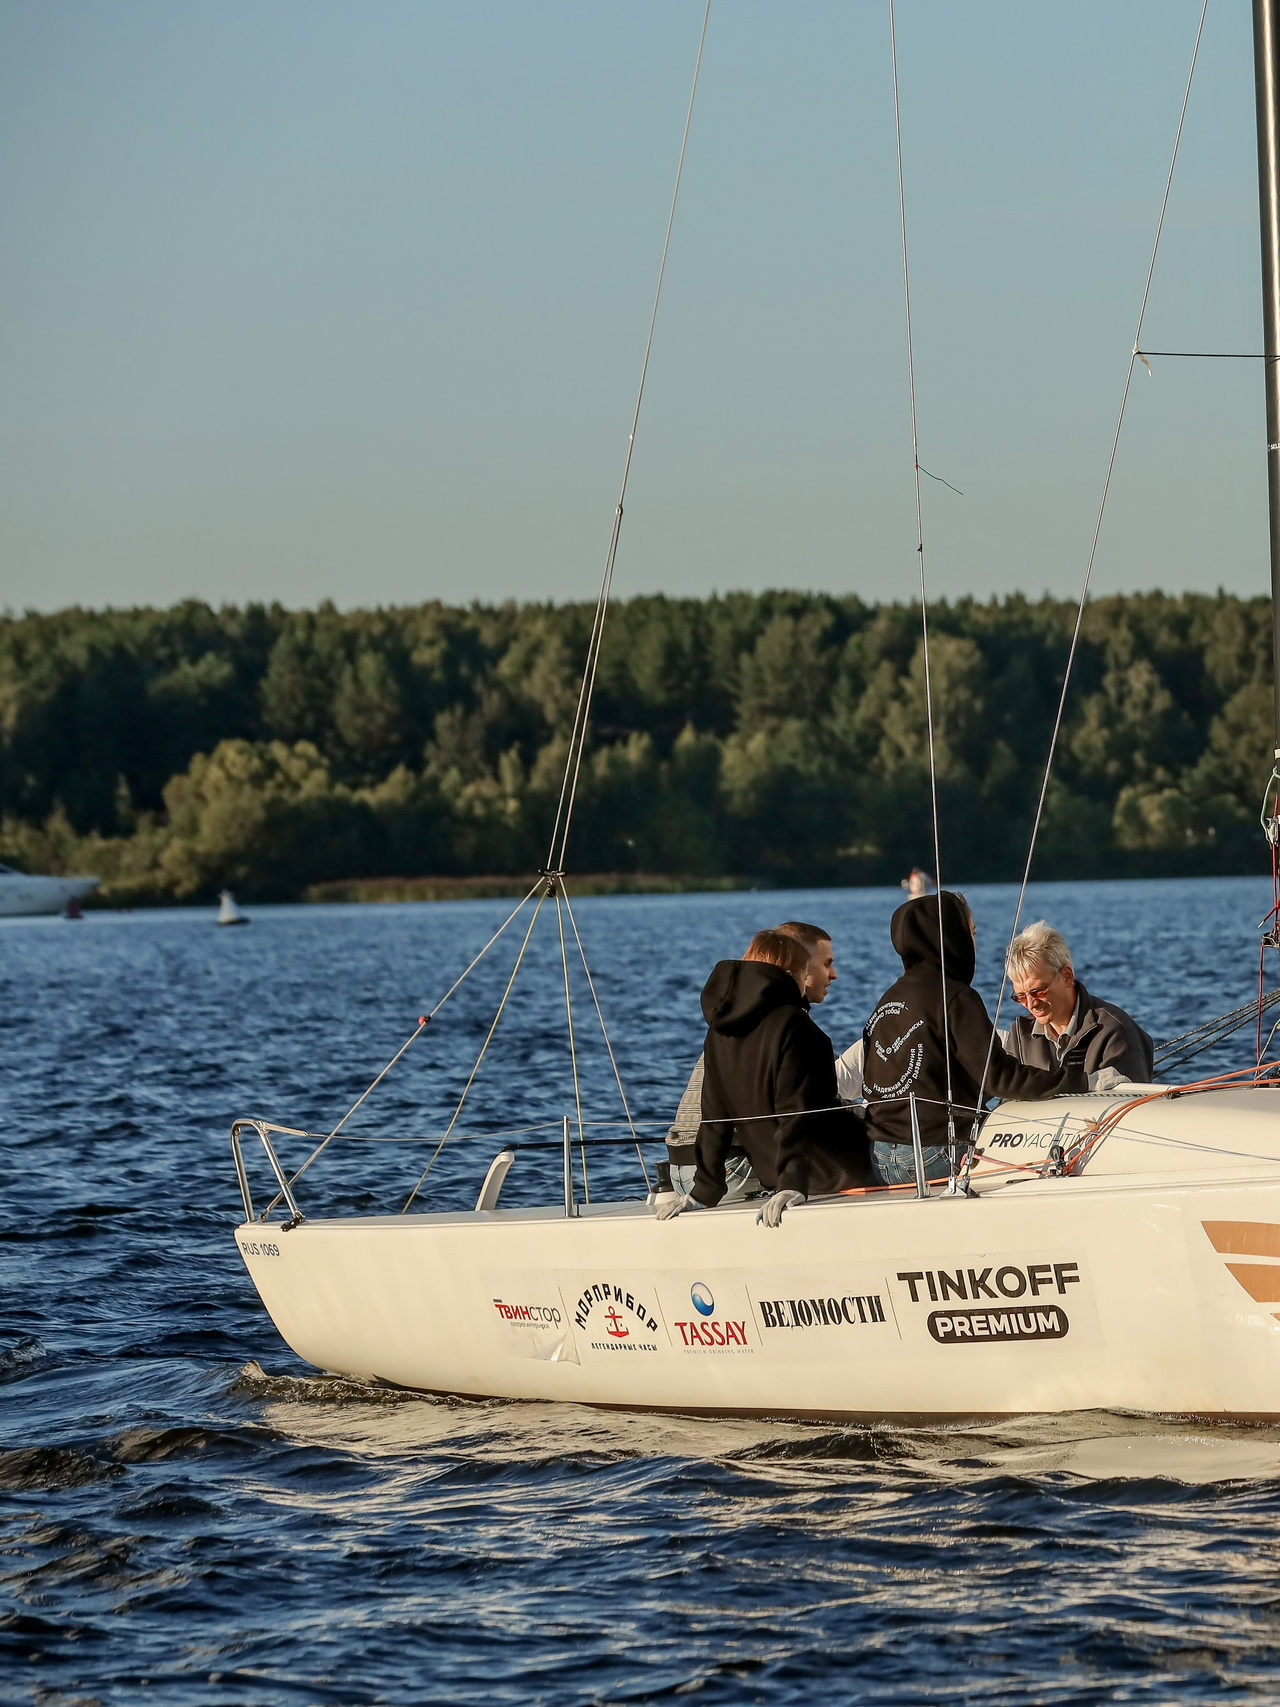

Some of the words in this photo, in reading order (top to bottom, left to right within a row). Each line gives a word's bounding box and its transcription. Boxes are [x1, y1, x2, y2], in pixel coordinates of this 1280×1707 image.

[241, 1242, 260, 1256] RUS
[260, 1243, 280, 1257] 1069
[896, 1262, 1080, 1303] TINKOFF
[575, 1283, 658, 1332] МОРПРИБОР
[758, 1295, 887, 1330] ВЕДОМОСТИ
[674, 1321, 748, 1346] TASSAY
[935, 1311, 1061, 1338] PREMIUM
[591, 1342, 637, 1351] ЛЕГЕНДАРНЫЕ
[639, 1343, 658, 1351] ЧАСЫ
